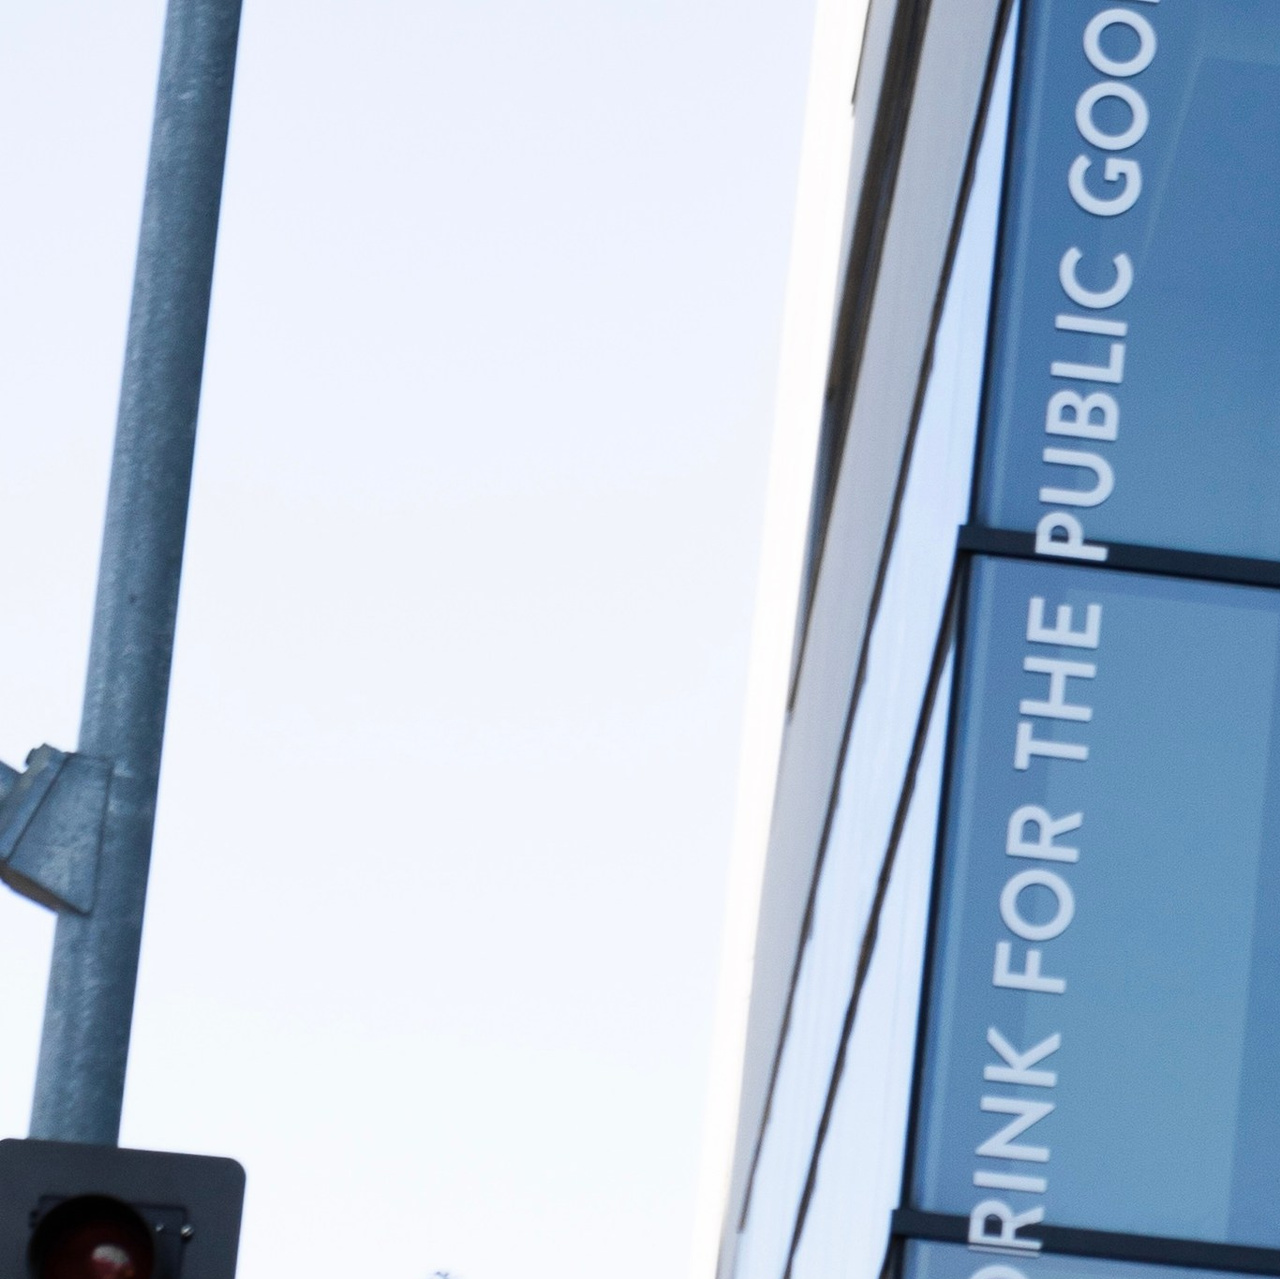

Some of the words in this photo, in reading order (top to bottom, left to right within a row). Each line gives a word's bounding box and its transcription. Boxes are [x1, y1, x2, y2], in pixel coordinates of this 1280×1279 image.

[1068, 0, 1160, 216] GOO
[1035, 247, 1133, 561] PUBLIC
[1014, 597, 1102, 769] THE
[993, 805, 1083, 993] FOR
